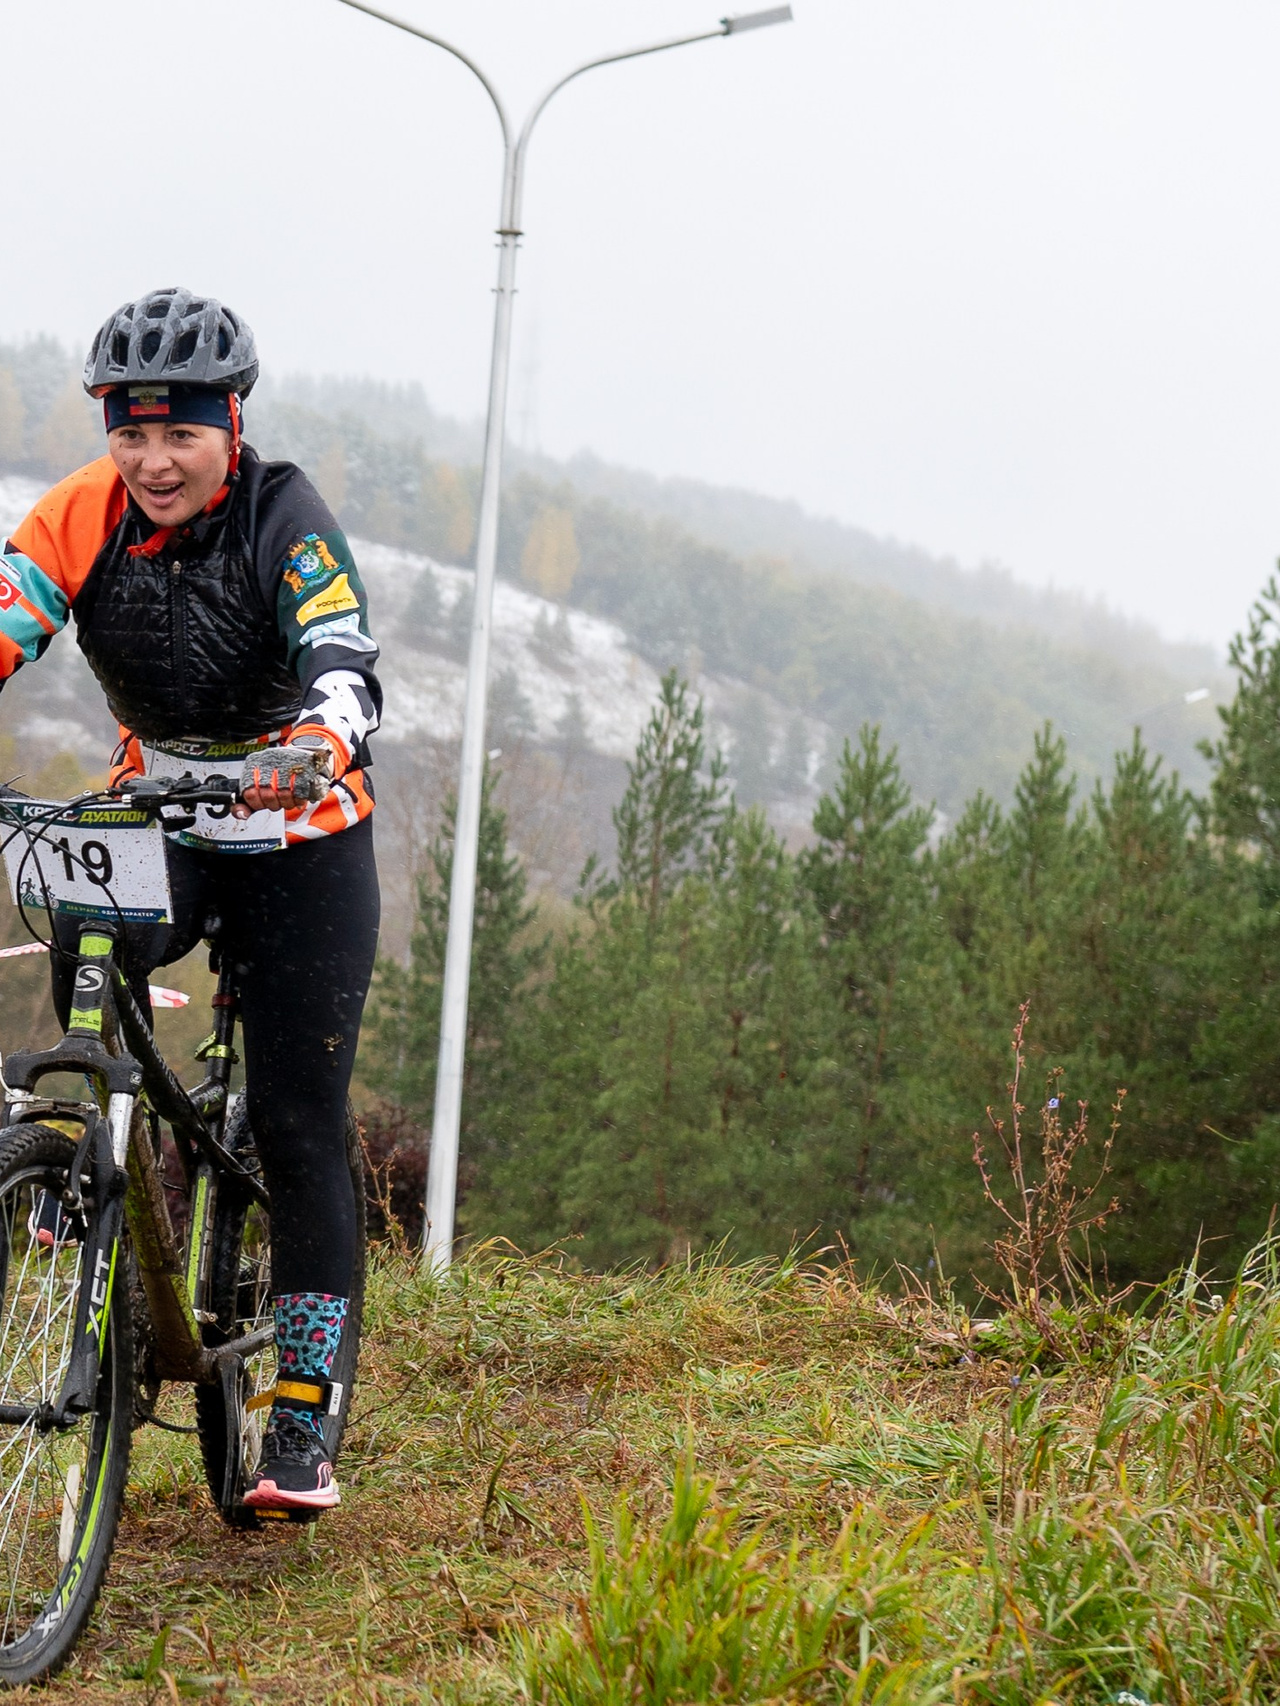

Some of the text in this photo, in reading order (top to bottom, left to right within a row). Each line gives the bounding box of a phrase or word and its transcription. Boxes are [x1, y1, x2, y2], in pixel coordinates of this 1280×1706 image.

[79, 811, 148, 824] ДУАТЛОН
[52, 837, 113, 885] 19
[85, 1249, 110, 1339] XCT
